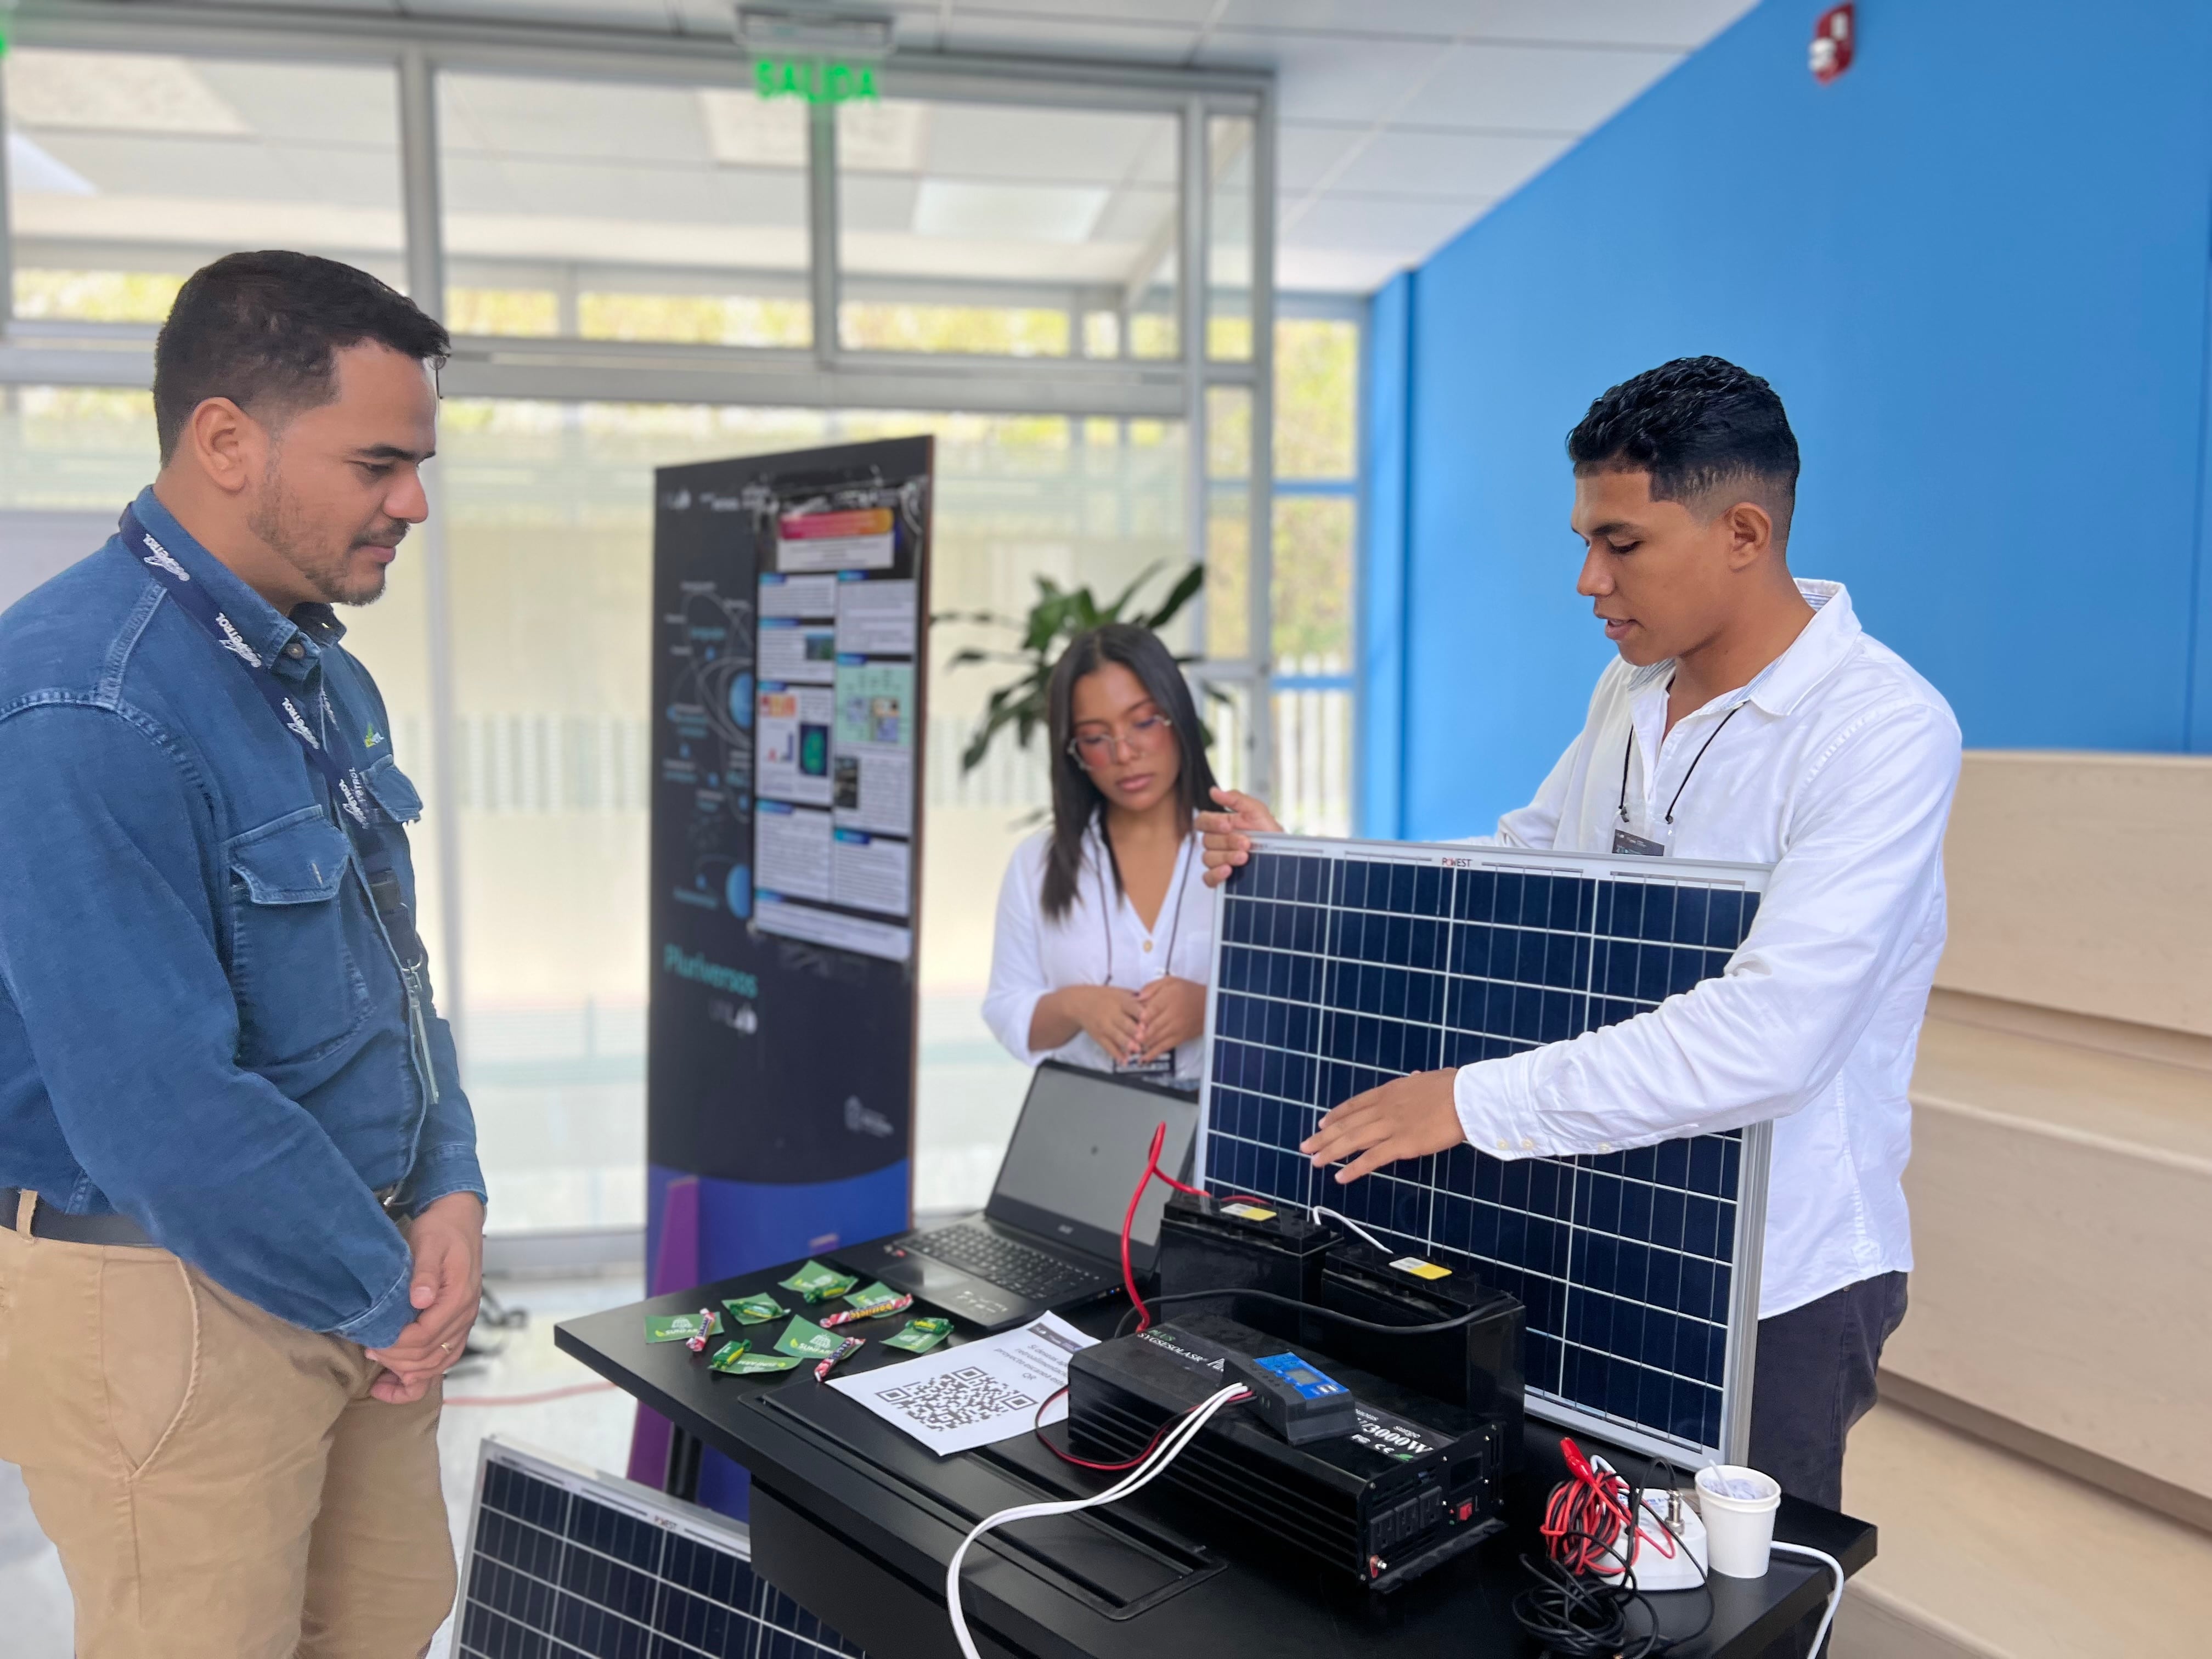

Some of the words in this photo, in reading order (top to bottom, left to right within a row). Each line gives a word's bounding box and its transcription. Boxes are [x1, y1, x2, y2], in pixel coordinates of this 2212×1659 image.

[754, 58, 879, 104] SALIDA
[663, 942, 759, 1000] Pluriversos
[798, 1342, 834, 1355] SUNFAR
[994, 1347, 1025, 1365] proyecto
[1022, 1372, 1037, 1381] QR
